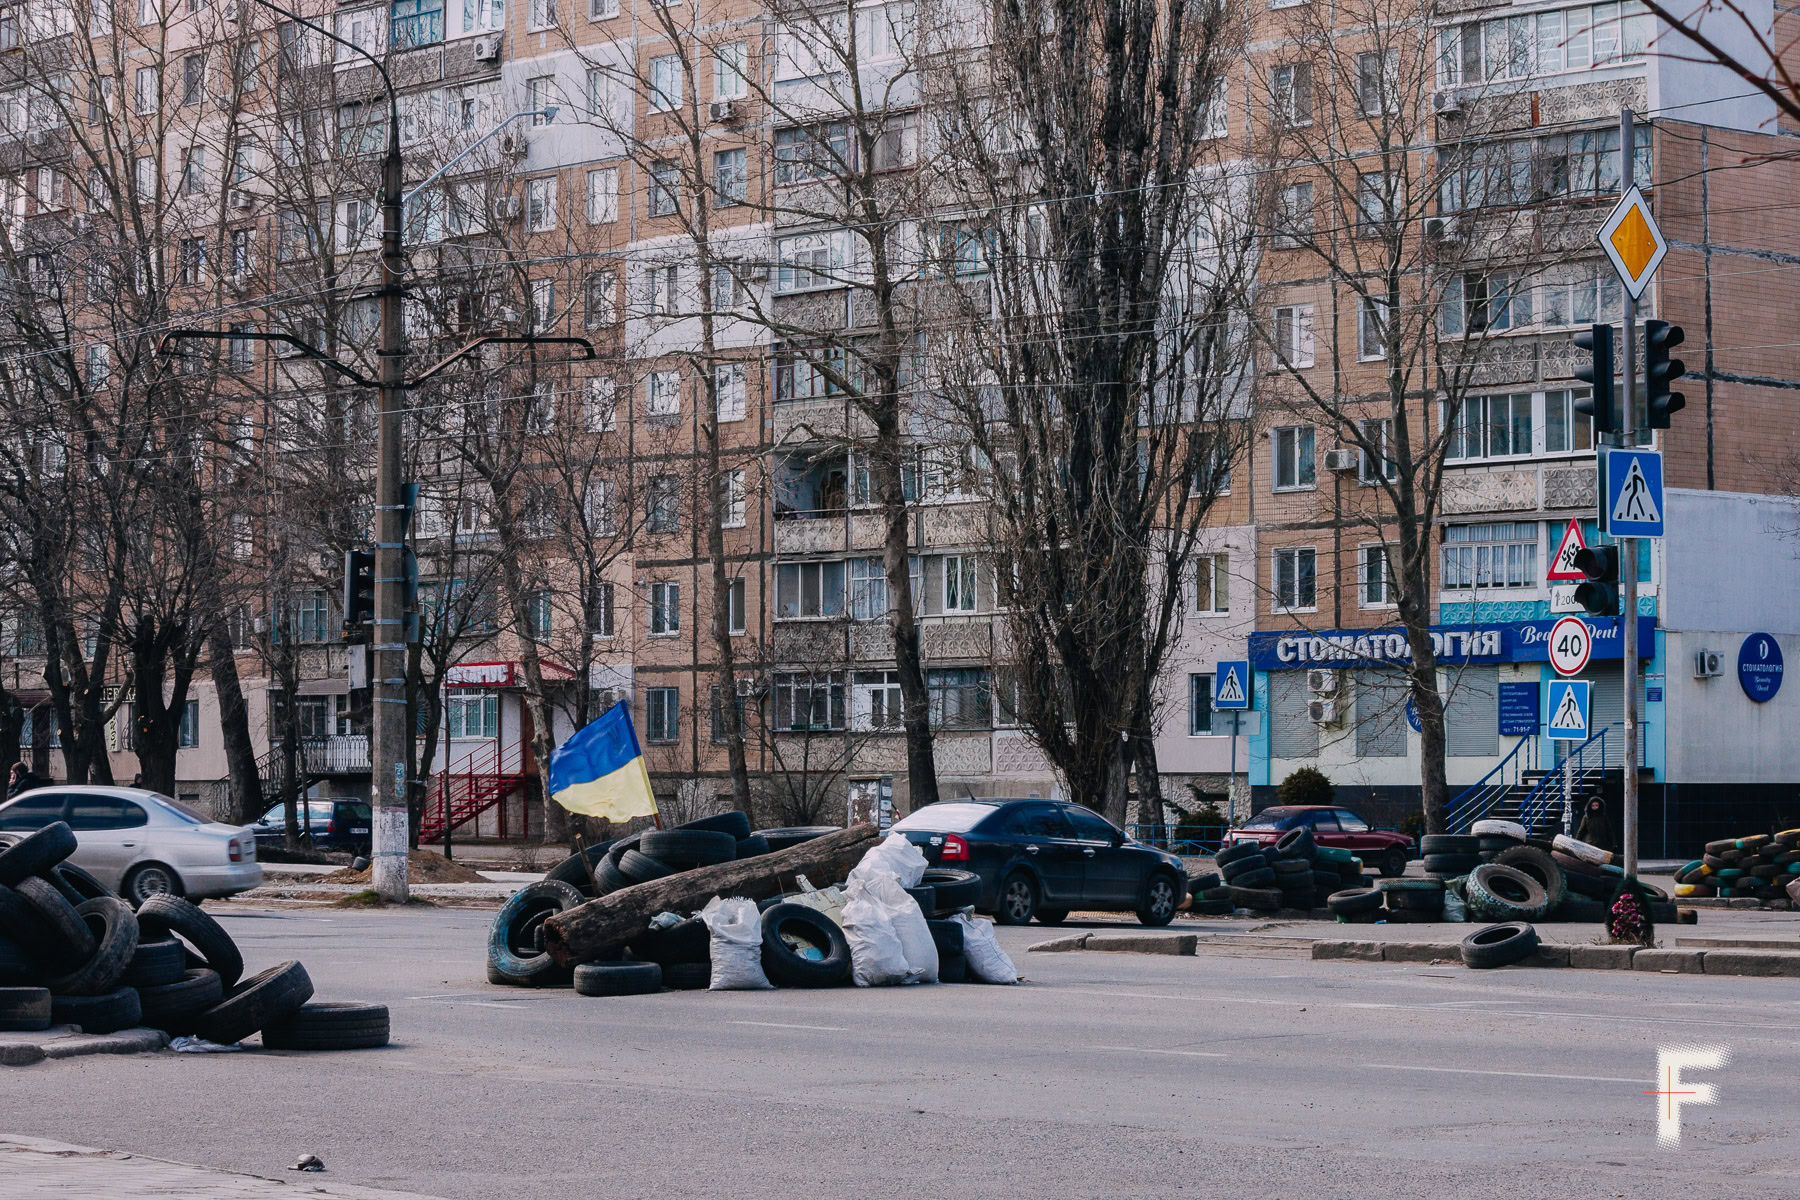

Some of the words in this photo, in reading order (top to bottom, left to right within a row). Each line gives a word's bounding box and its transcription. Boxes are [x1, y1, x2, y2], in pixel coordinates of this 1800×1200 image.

[1519, 625, 1552, 645] Bea
[1557, 634, 1582, 657] 40
[1277, 631, 1501, 662] СТОМАТООГИЯ
[1742, 663, 1783, 673] СТОМАТОЛОГИЯ
